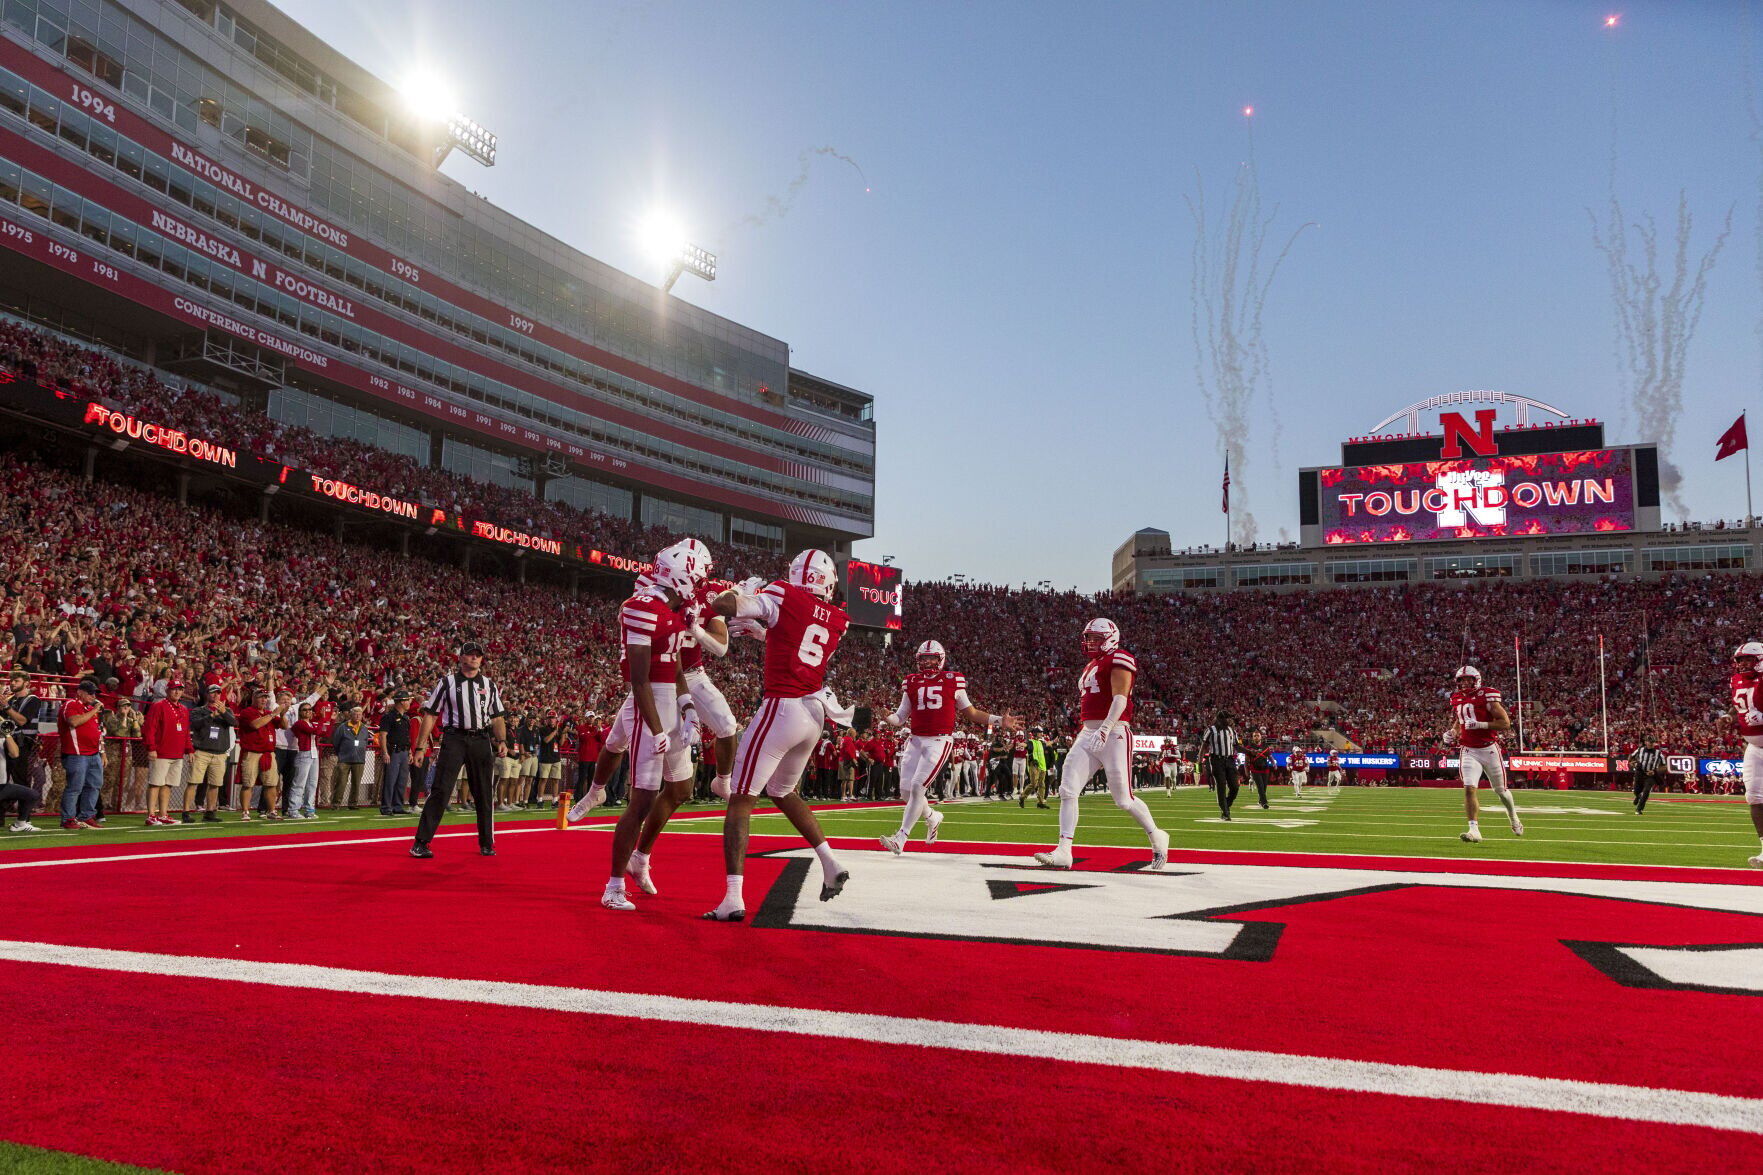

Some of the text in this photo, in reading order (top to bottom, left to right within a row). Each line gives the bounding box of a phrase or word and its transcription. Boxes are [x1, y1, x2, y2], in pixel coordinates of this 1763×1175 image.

[71, 84, 116, 123] 1994
[171, 142, 348, 248] NATIONAL CHAMPIONS
[1, 220, 120, 282] 1975 1978 1981
[151, 211, 355, 318] NEBRASKA N FOOTBALL
[391, 258, 420, 283] 1995
[173, 297, 328, 368] CONFERENCE CHAMPIONS
[509, 314, 535, 335] 1997
[93, 405, 237, 468] TOUCHDOWN
[369, 375, 627, 470] 1982 1983 1984 1988 1991 1992 1993 1994 1995 1997 1999
[1348, 417, 1598, 446] MEMORIAL STADIUM
[1438, 408, 1500, 459] N
[311, 475, 418, 520] TOUCHDOWN
[1338, 478, 1615, 517] TOUCHDOWN
[475, 520, 562, 556] TOUCHDOWN
[807, 572, 815, 583] 6
[813, 604, 832, 623] KEY
[797, 623, 830, 667] 6
[917, 685, 943, 711] 15
[1456, 703, 1477, 725] 10
[1733, 687, 1756, 713] 51
[1348, 757, 1359, 765] THE
[1410, 759, 1430, 768] 2:08
[1615, 759, 1629, 771] N
[1671, 759, 1692, 771] 40
